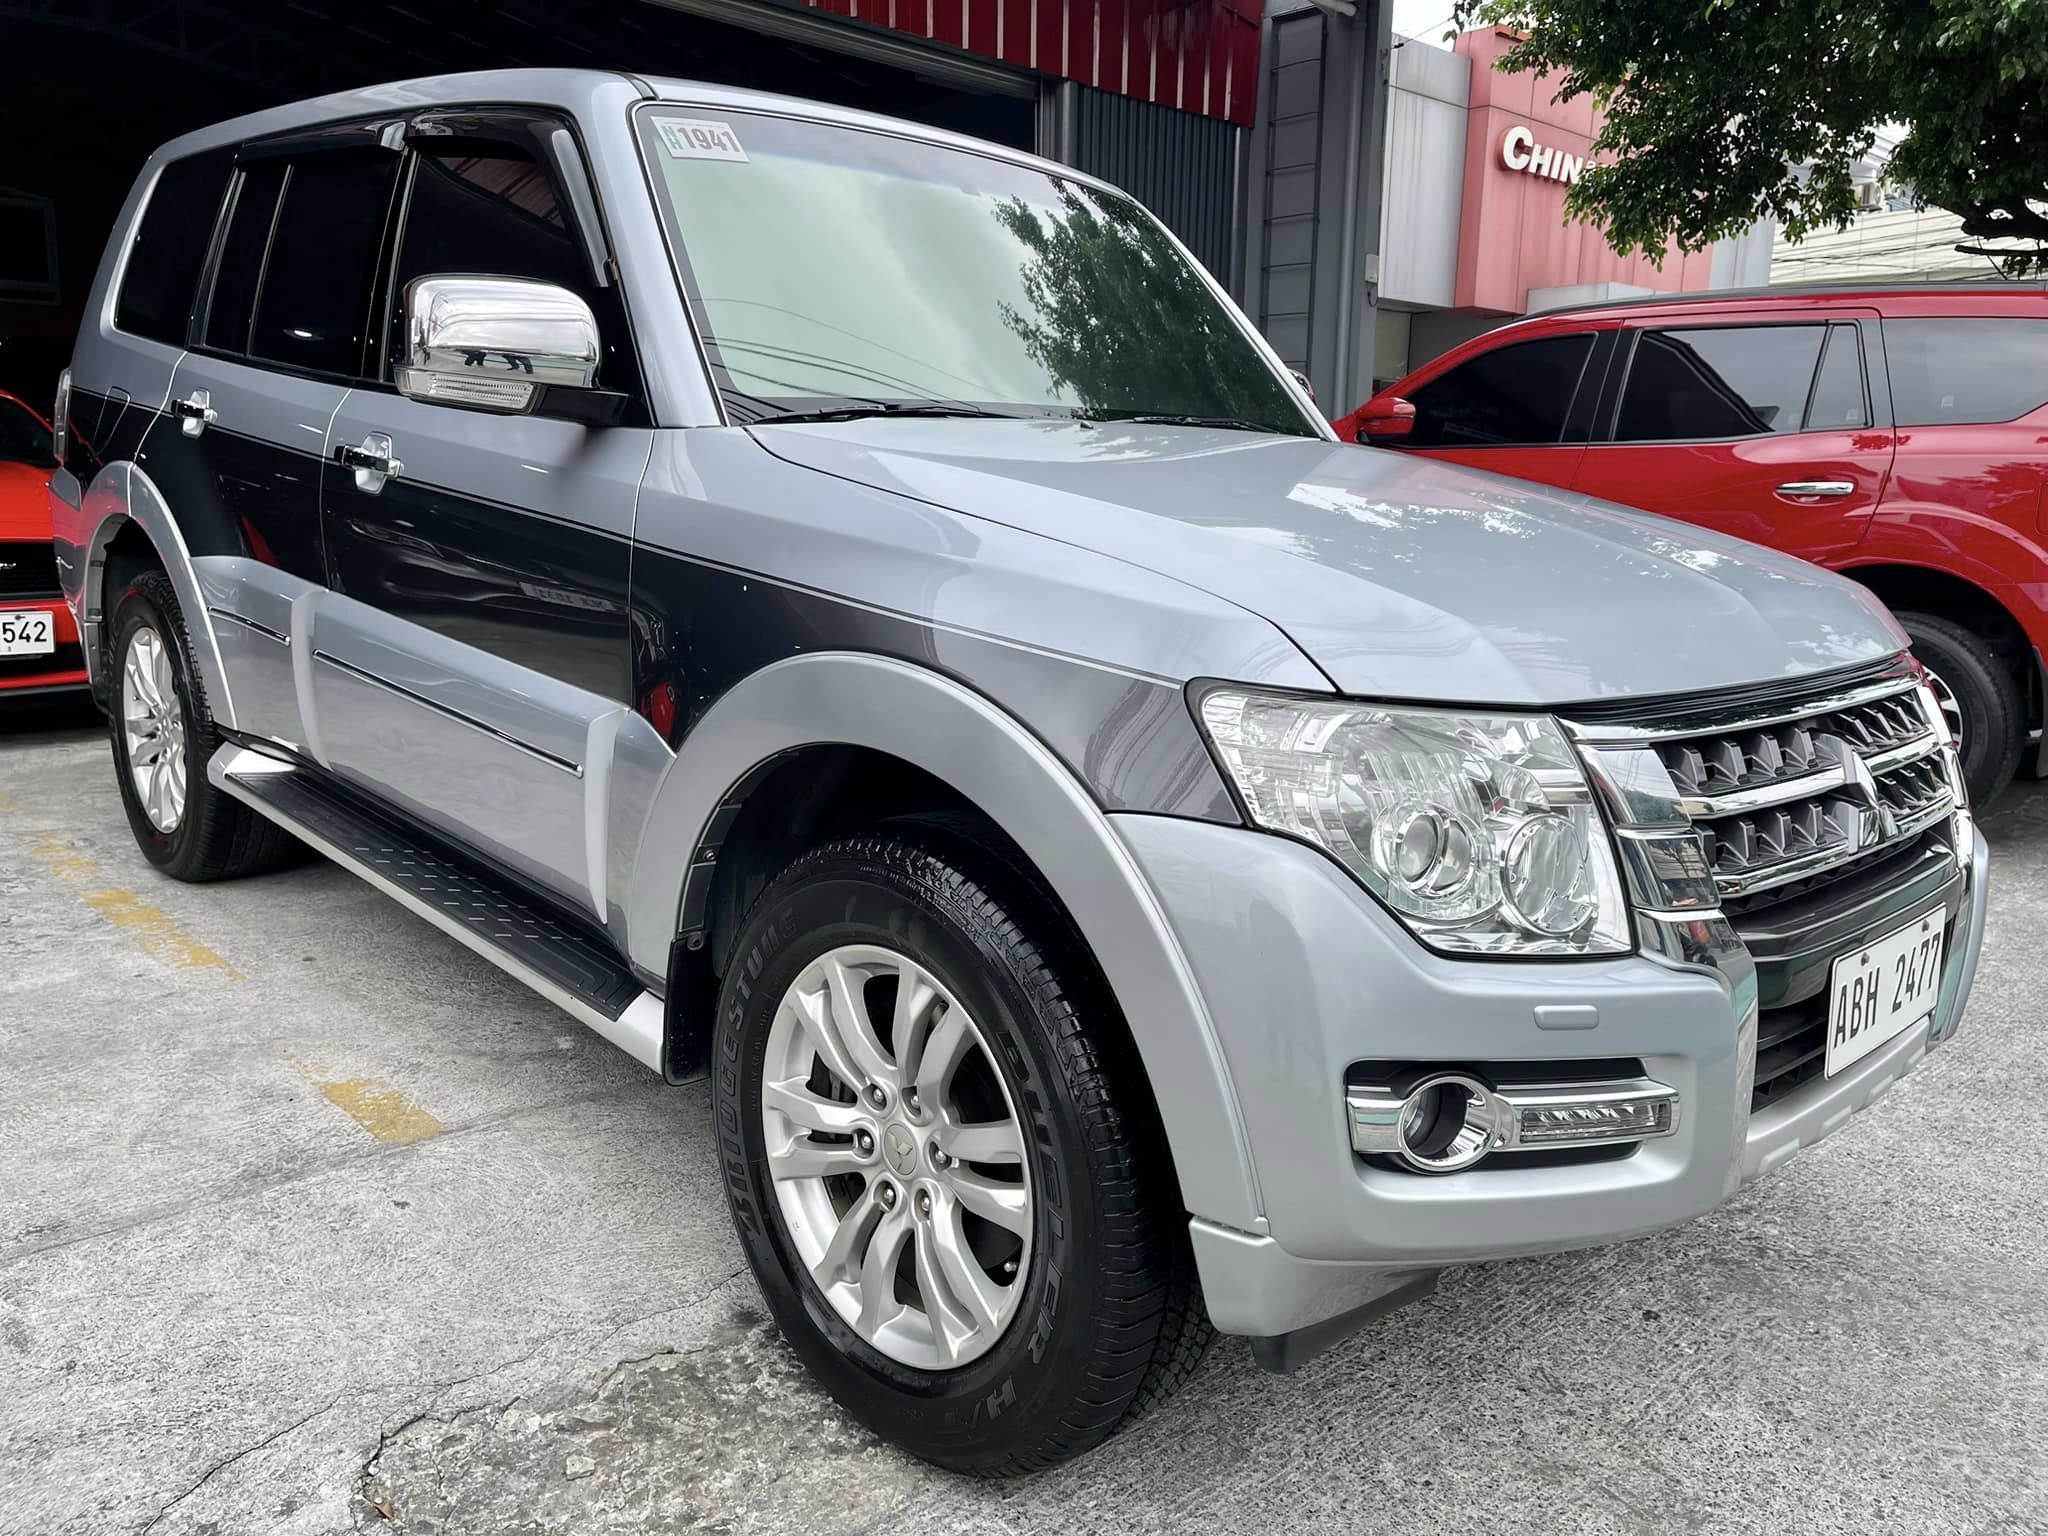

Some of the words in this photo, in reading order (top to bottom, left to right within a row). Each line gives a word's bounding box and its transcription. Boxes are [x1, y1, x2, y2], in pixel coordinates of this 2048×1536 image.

[677, 127, 741, 153] 1941
[2, 620, 47, 643] 542
[1834, 966, 1881, 1049] ABH
[1891, 931, 1941, 1014] 2477
